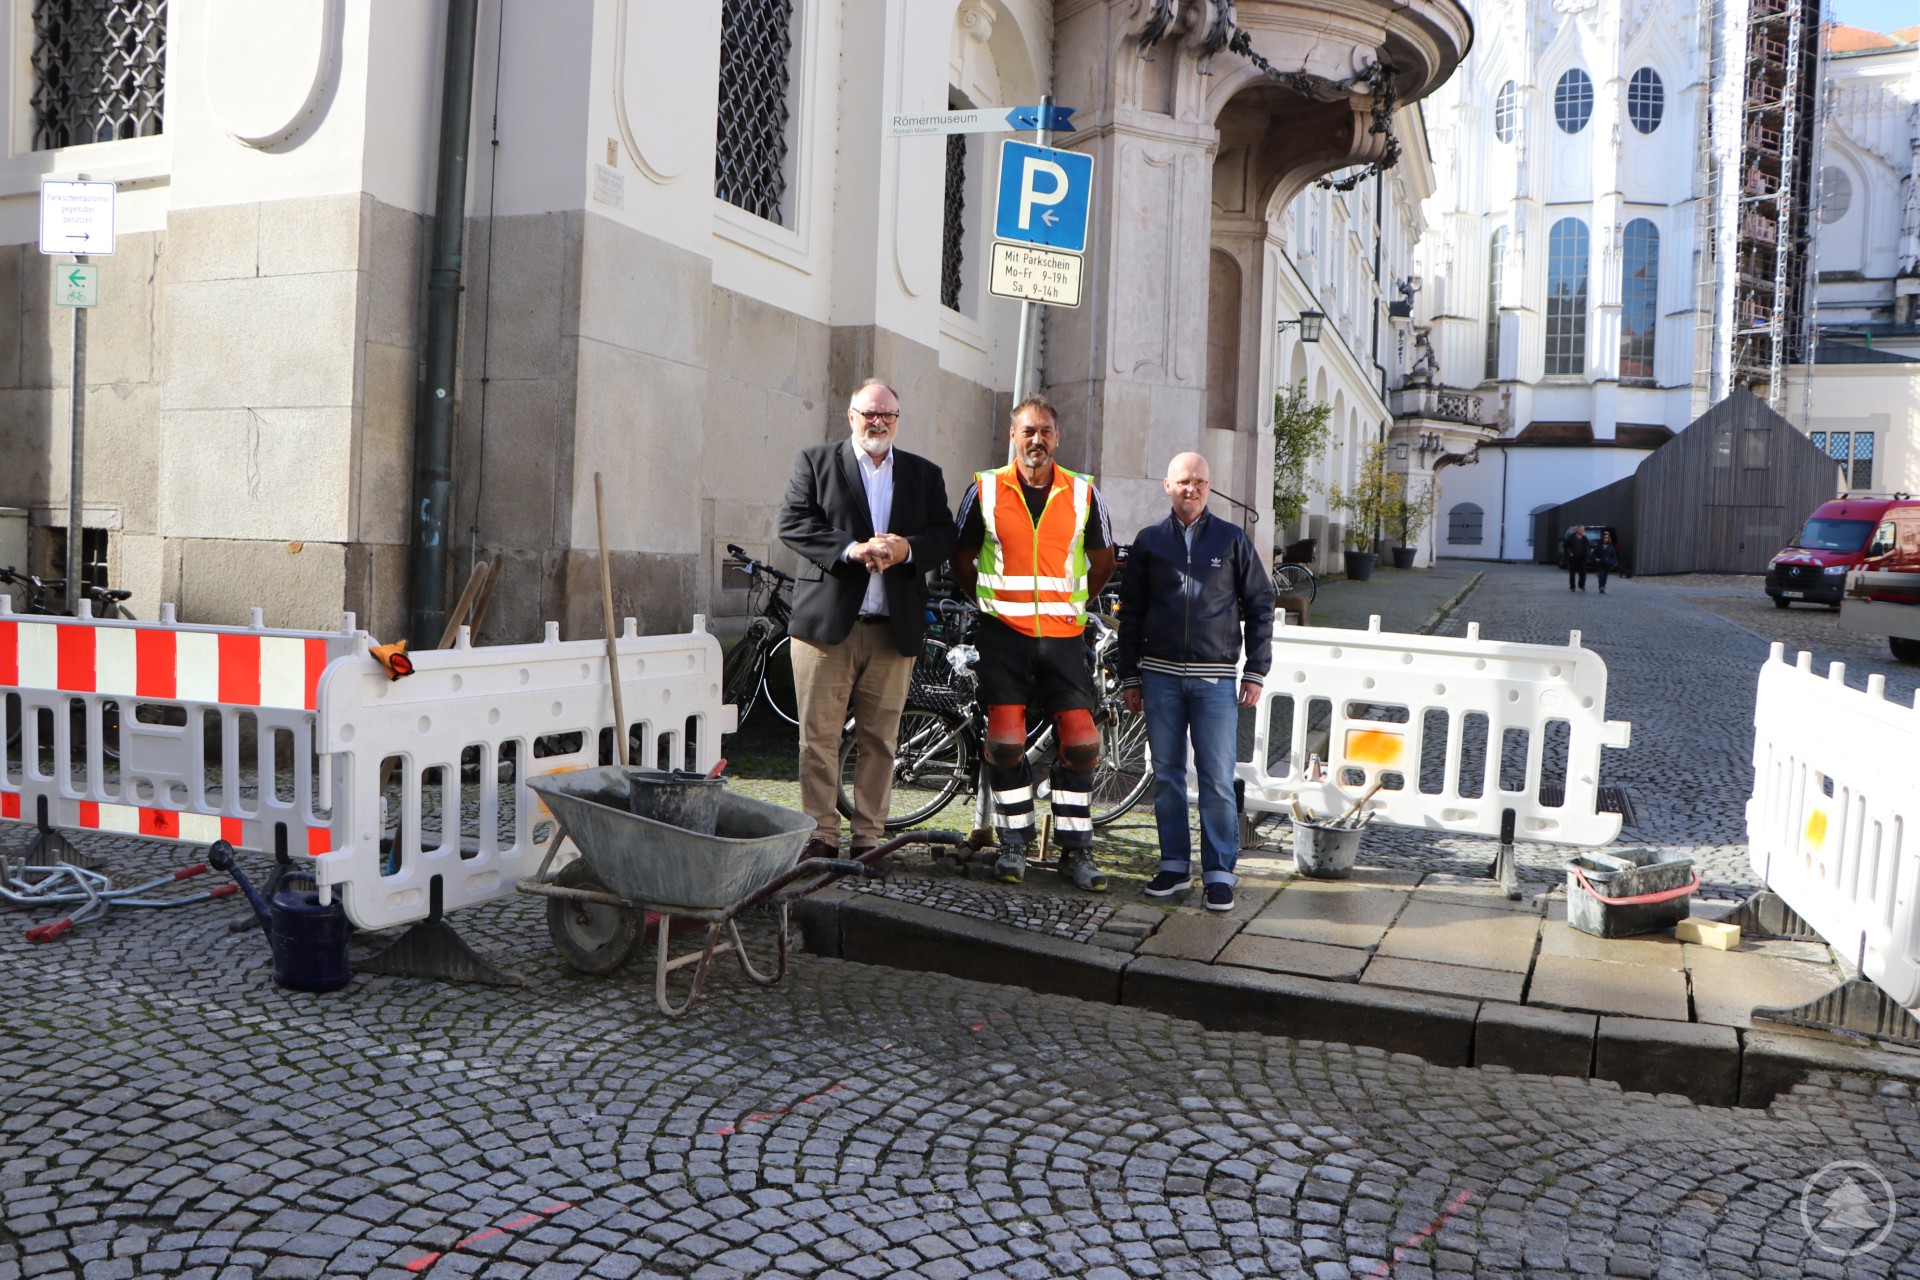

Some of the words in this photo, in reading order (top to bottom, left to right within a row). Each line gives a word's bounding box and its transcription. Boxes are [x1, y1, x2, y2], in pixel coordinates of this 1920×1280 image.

[893, 114, 978, 126] Römermuseum
[1018, 156, 1069, 230] P
[1005, 250, 1019, 262] Mit
[1023, 253, 1070, 271] Parkschein
[1005, 265, 1032, 279] Mo-Fr
[1012, 280, 1023, 292] Sa
